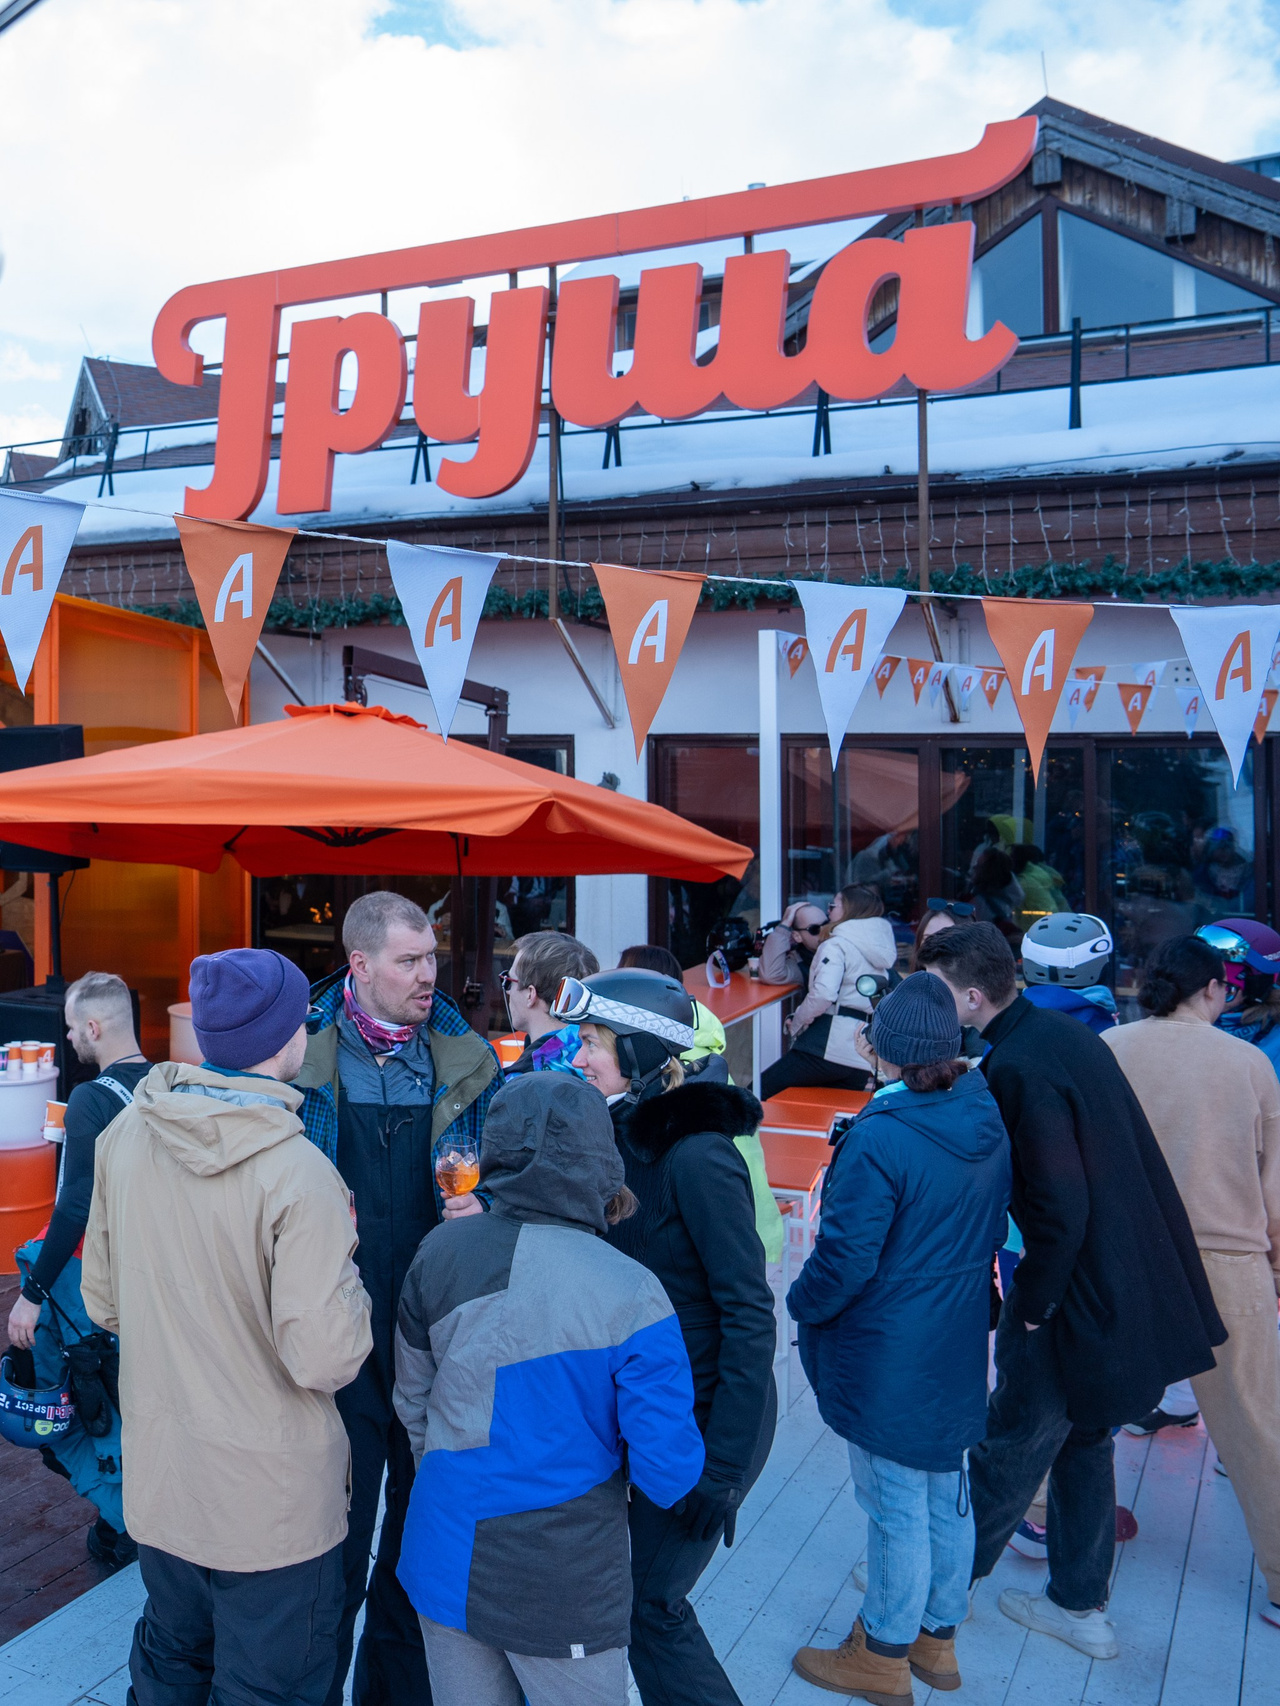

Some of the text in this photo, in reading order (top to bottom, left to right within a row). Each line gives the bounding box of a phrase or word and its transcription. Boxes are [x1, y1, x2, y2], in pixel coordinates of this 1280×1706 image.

[1, 525, 44, 596] A
[214, 552, 254, 623] A
[425, 576, 463, 648] A
[628, 599, 668, 665] A
[825, 608, 868, 673] A
[1021, 628, 1055, 696] A
[1215, 630, 1251, 701] A
